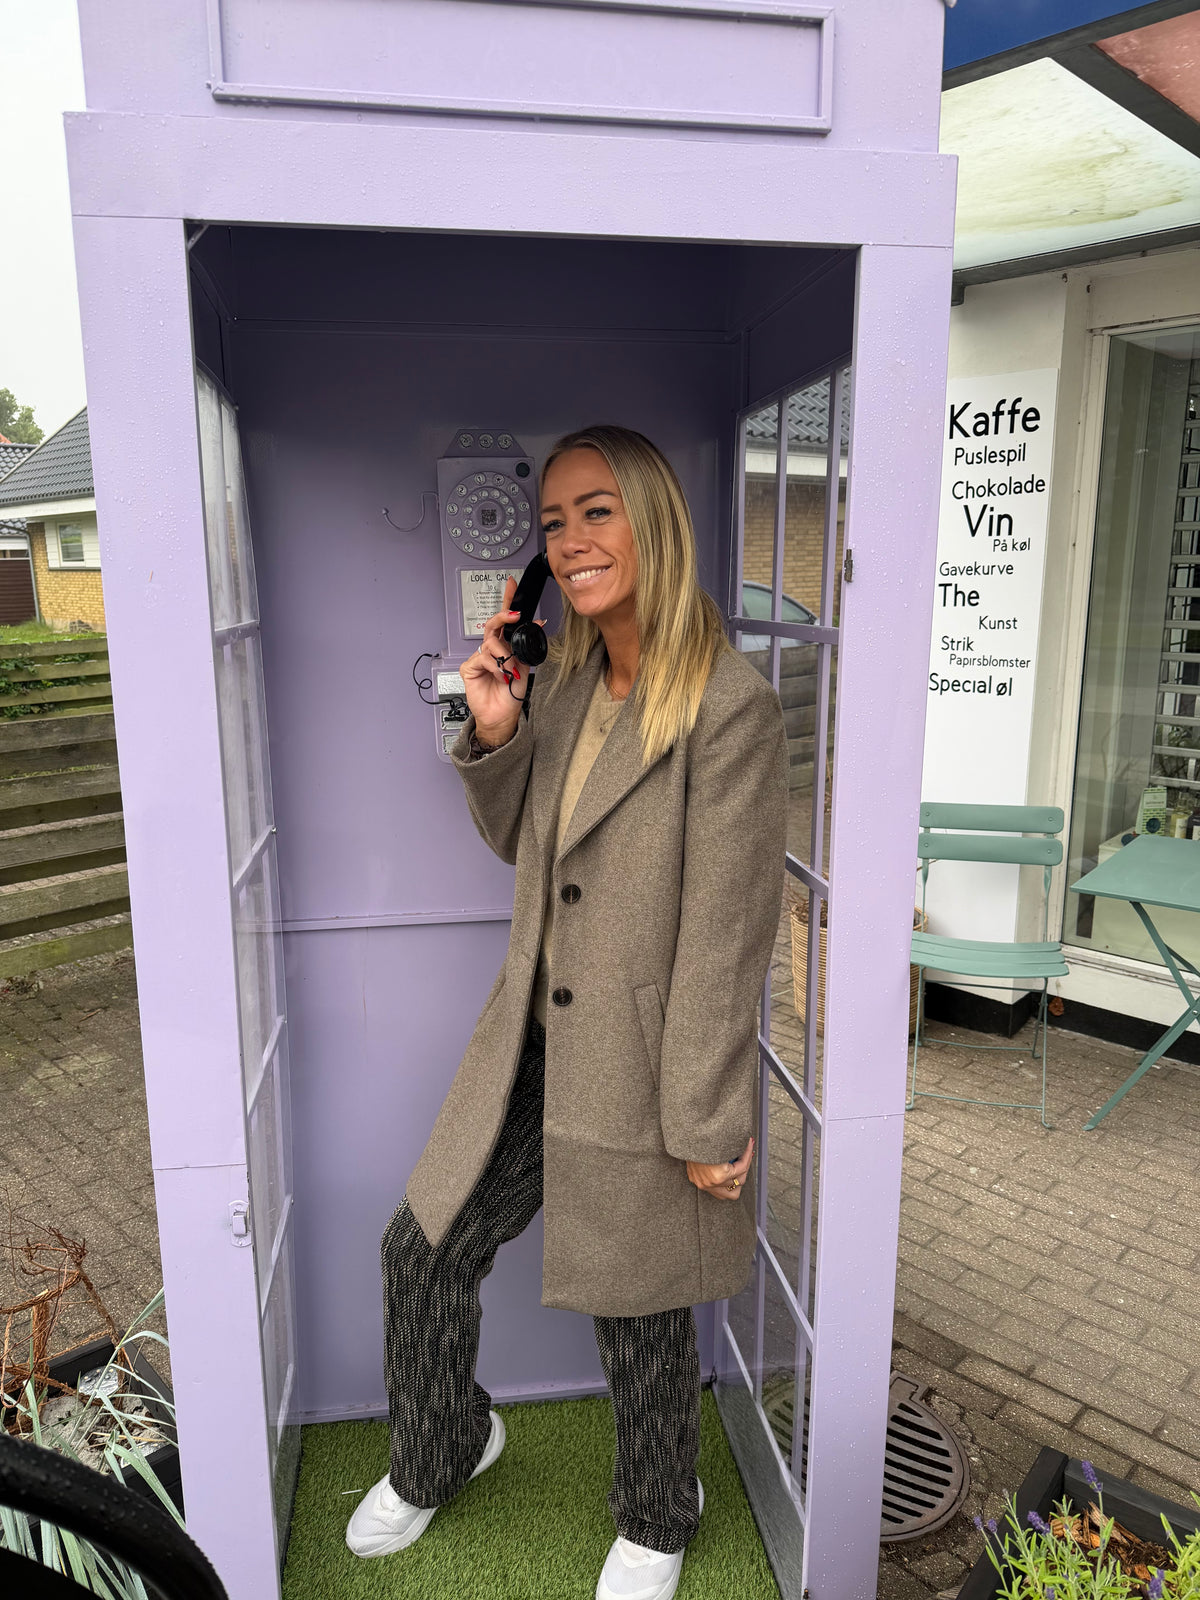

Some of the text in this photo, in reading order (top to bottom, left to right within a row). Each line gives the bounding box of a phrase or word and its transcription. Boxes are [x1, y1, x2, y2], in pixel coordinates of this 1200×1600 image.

[948, 396, 1041, 441] Kaffe
[954, 442, 1027, 467] Puslespil
[951, 473, 1046, 500] Chokolade
[963, 503, 1014, 538] Vin
[992, 537, 1031, 552] På køl
[470, 573, 512, 582] LOCAL CAL
[939, 561, 1014, 577] Gavekurve
[938, 582, 980, 608] The
[978, 615, 1018, 630] Kunst
[941, 635, 974, 652] Strik
[996, 677, 1013, 697] øl
